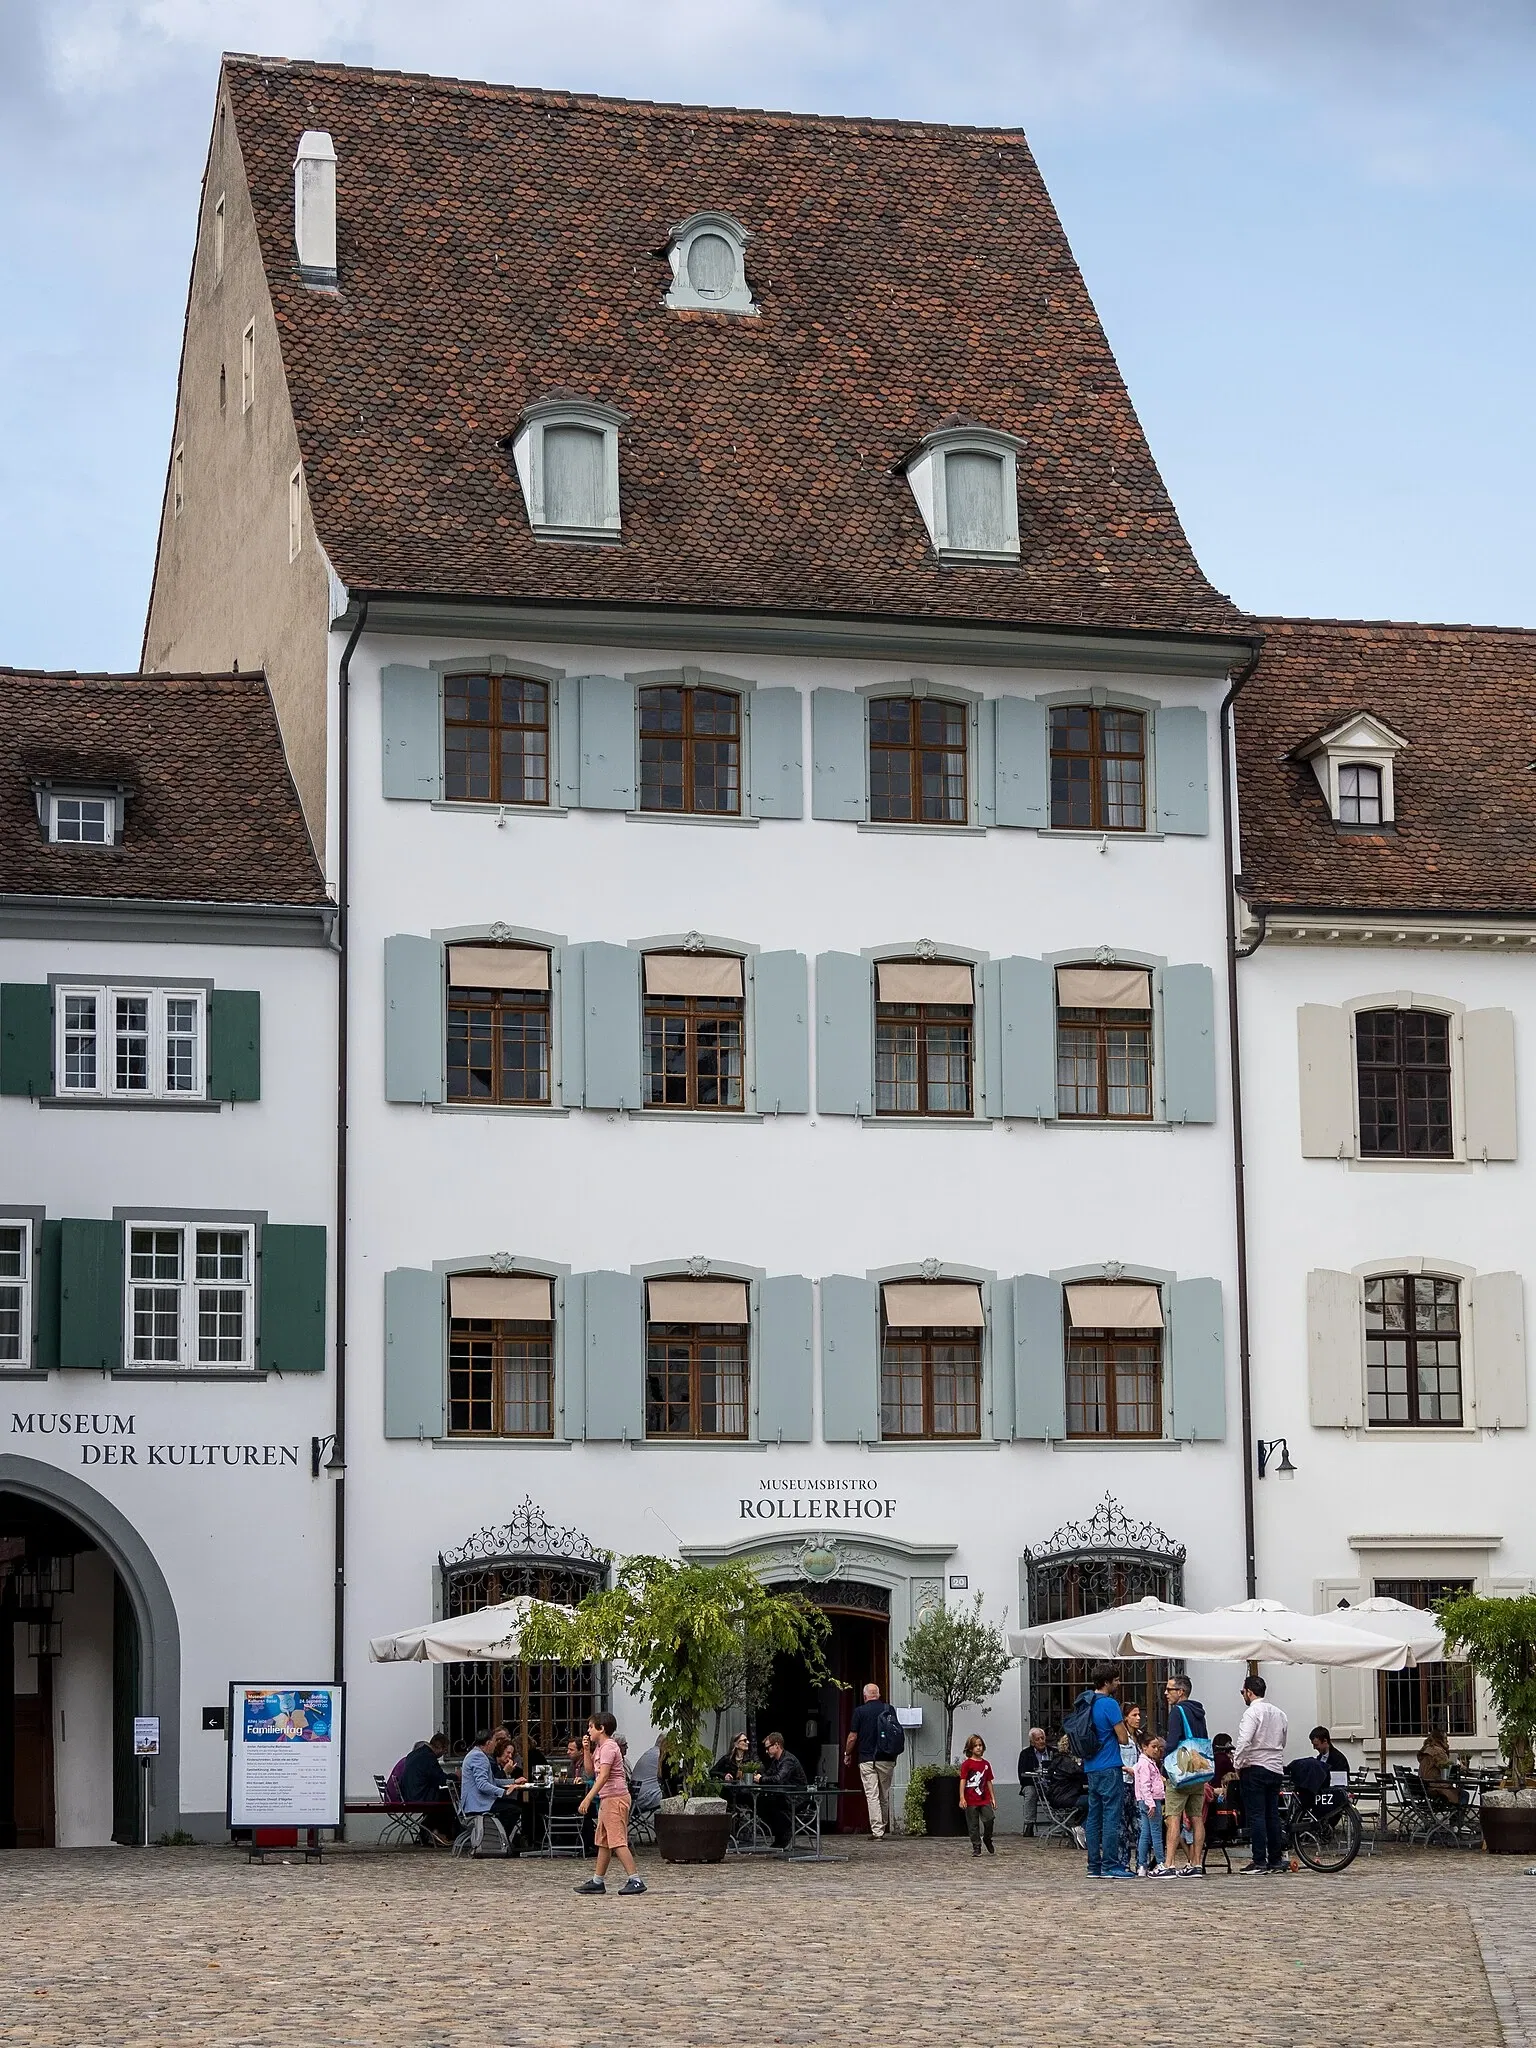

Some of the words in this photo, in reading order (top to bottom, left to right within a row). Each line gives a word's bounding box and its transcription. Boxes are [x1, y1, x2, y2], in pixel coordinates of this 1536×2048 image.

[10, 1413, 136, 1435] MUSEUM
[80, 1444, 139, 1466] DER
[147, 1445, 300, 1467] KULTUREN
[759, 1479, 878, 1490] MUSEUMSBISTRO
[738, 1499, 897, 1519] ROLLERHOF
[952, 1578, 965, 1587] 20
[247, 1724, 303, 1736] Familientag
[1315, 1794, 1334, 1806] PEZ
